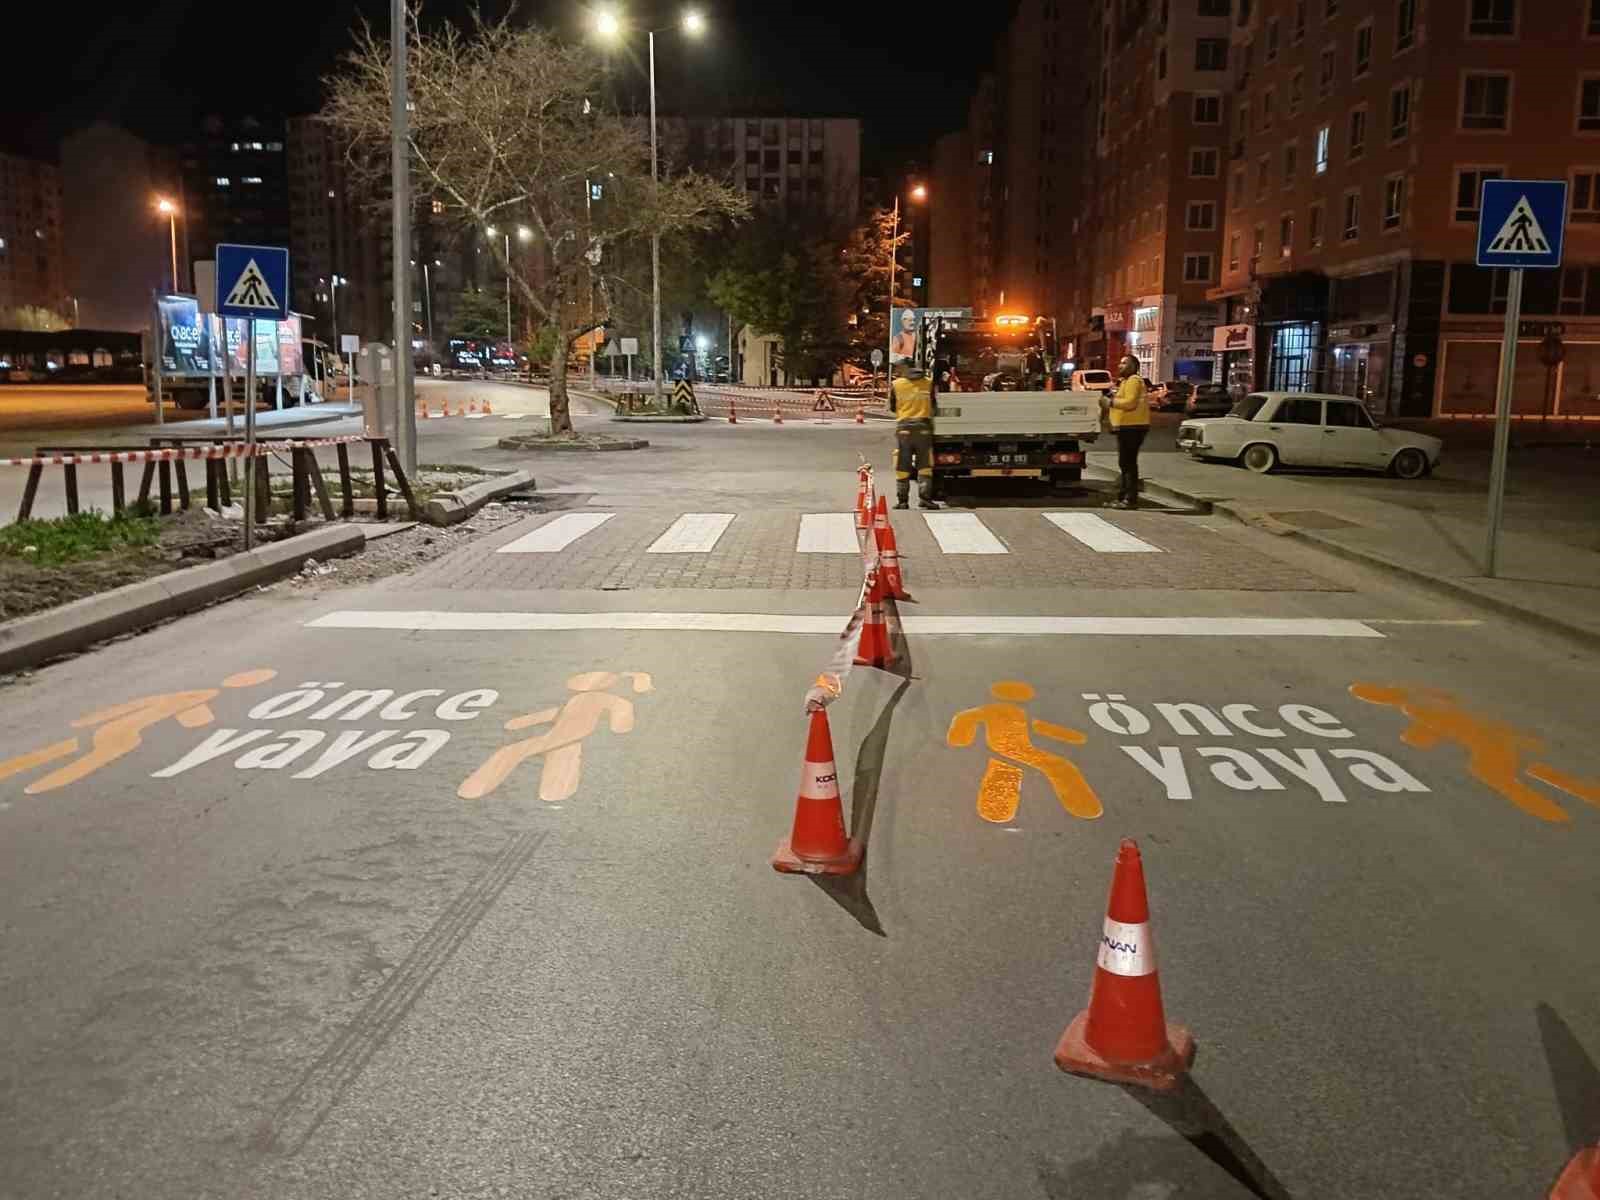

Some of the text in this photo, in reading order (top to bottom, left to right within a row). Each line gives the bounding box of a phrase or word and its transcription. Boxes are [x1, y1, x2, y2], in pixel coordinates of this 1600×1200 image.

[248, 682, 499, 720] önce
[1081, 693, 1356, 738] önce
[150, 729, 451, 779] yaya
[1119, 746, 1432, 802] yaya
